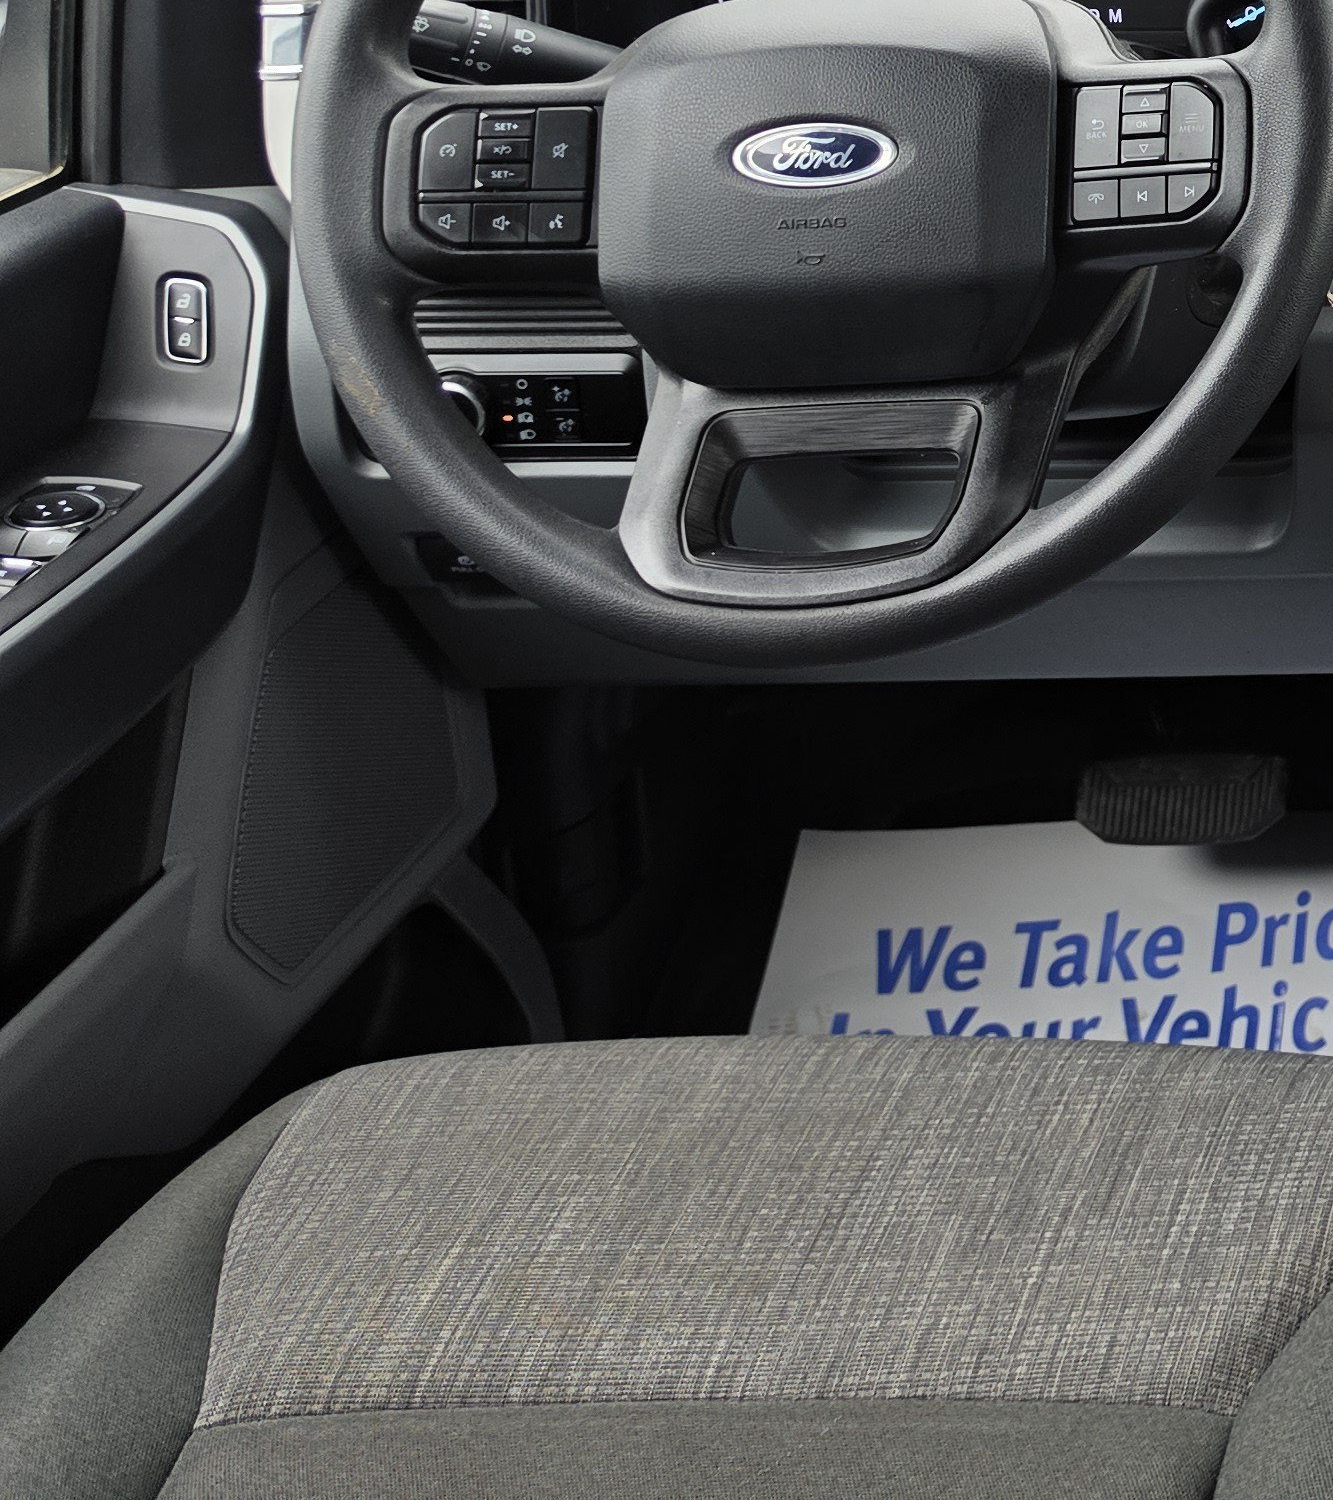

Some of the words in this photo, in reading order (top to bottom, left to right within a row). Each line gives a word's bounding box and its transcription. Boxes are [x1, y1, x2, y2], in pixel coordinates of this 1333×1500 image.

[1108, 8, 1123, 23] M
[494, 122, 519, 131] SET+
[1135, 120, 1148, 129] OK
[1180, 125, 1205, 133] MENU
[1086, 131, 1107, 140] BACK
[772, 136, 856, 171] Ford
[777, 217, 848, 230] AIRBAG
[875, 925, 986, 995] We
[1014, 909, 1185, 989] Take
